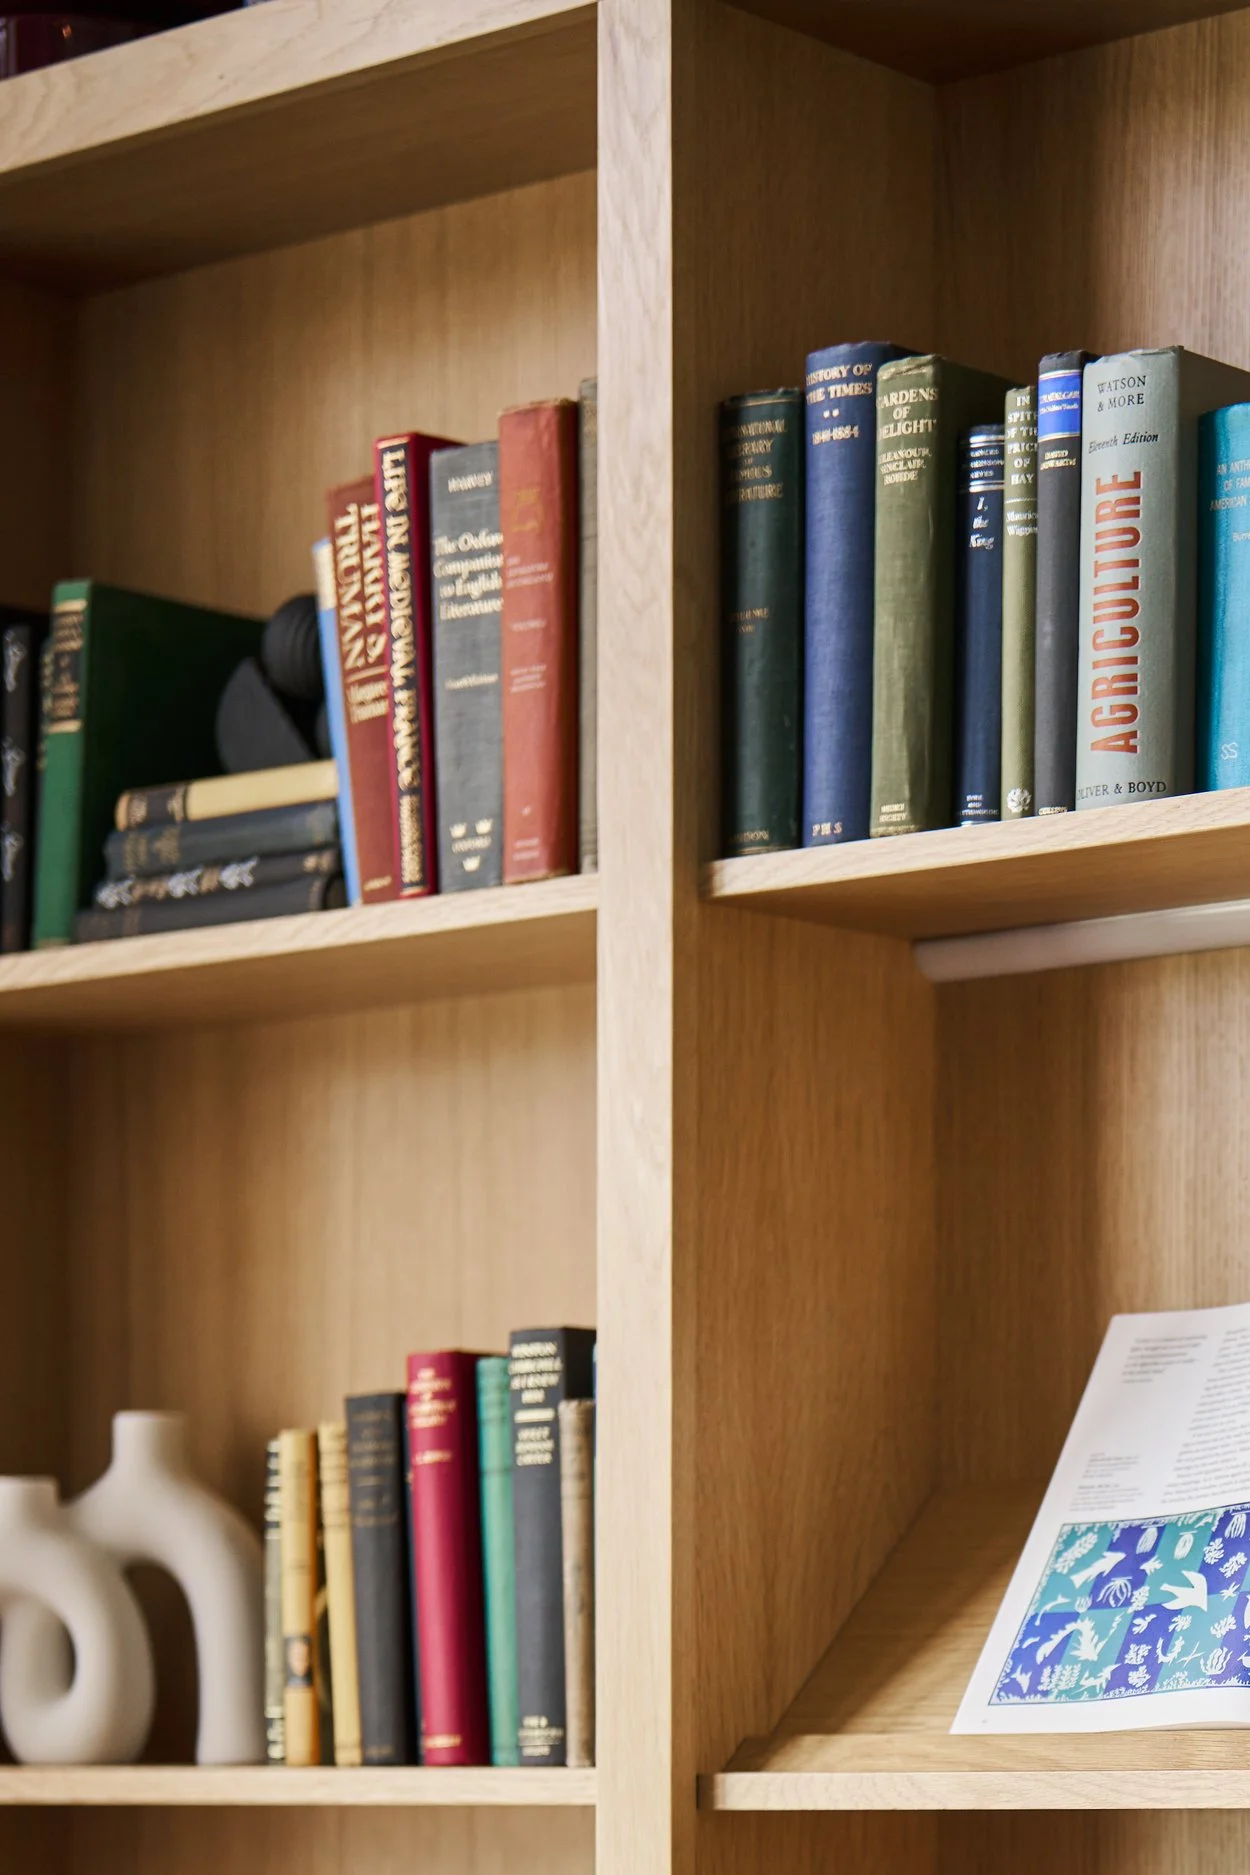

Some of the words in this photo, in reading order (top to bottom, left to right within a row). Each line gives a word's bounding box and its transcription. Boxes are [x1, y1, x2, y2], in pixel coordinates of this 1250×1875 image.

[852, 362, 873, 377] OF
[828, 381, 873, 400] TIMES
[1096, 374, 1148, 394] WATSON
[1016, 396, 1031, 406] IN
[1096, 400, 1105, 412] &
[1108, 393, 1146, 408] MORE
[892, 406, 911, 420] OF
[1006, 428, 1018, 440] OF
[1088, 436, 1119, 455] Eleventh
[1122, 432, 1160, 446] Edition
[1013, 457, 1031, 469] OF
[1217, 462, 1228, 475] AN
[382, 448, 409, 514] LIFE
[1010, 473, 1035, 485] HAY
[1223, 481, 1234, 493] OF
[1209, 495, 1248, 512] AMERICAN
[385, 514, 410, 551] IN
[360, 502, 388, 627] HARRY
[334, 502, 366, 670] TRUMAN
[387, 552, 417, 686] MEDIEVAL
[1089, 469, 1143, 756] AGRICULTURE
[1113, 783, 1124, 794] &
[1128, 780, 1168, 795] BOYD
